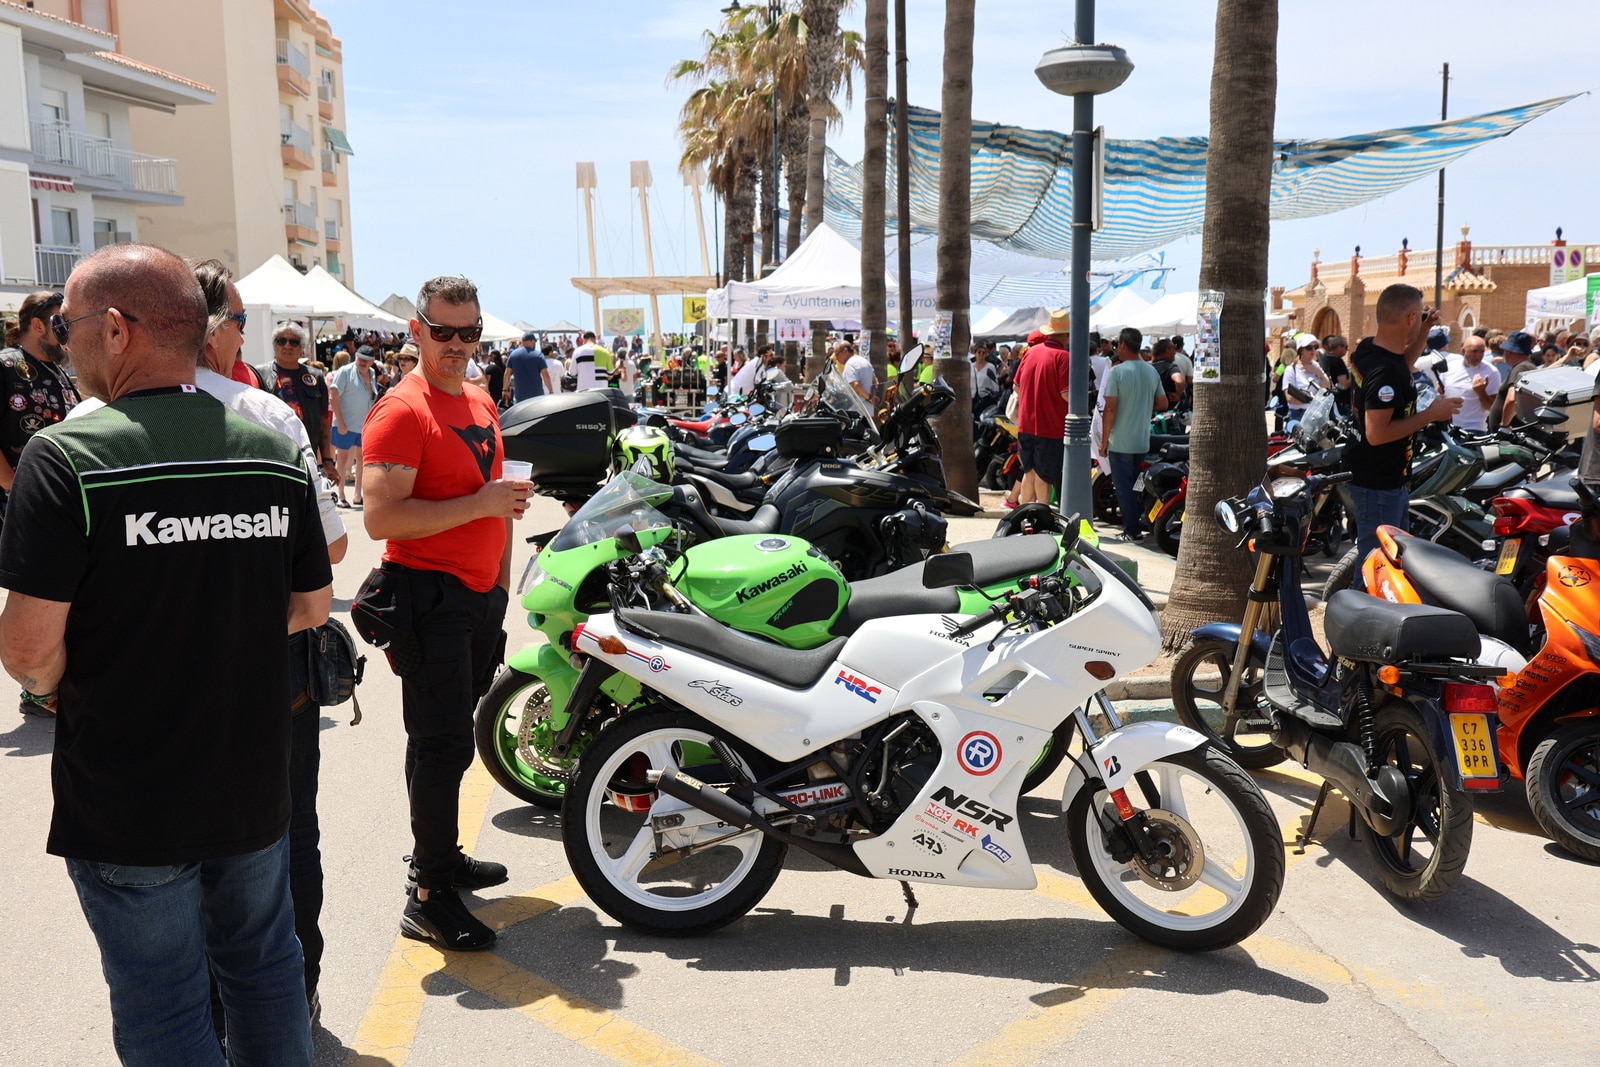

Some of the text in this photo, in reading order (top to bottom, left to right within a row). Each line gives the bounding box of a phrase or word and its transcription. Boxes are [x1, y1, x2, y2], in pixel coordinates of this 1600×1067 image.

[783, 295, 861, 309] Ayuntamien
[1555, 300, 1585, 313] Ayunta
[125, 506, 290, 546] Kawasaki
[735, 560, 809, 604] Kawasaki
[929, 630, 970, 647] HONDA
[1069, 643, 1121, 657] SUPER SPRINT
[834, 670, 882, 704] HRC
[1462, 722, 1477, 735] C7
[1461, 738, 1486, 751] 336
[925, 801, 953, 823] NGK
[929, 785, 1014, 833] NSR
[953, 818, 980, 838] RK
[888, 867, 946, 880] HONDA
